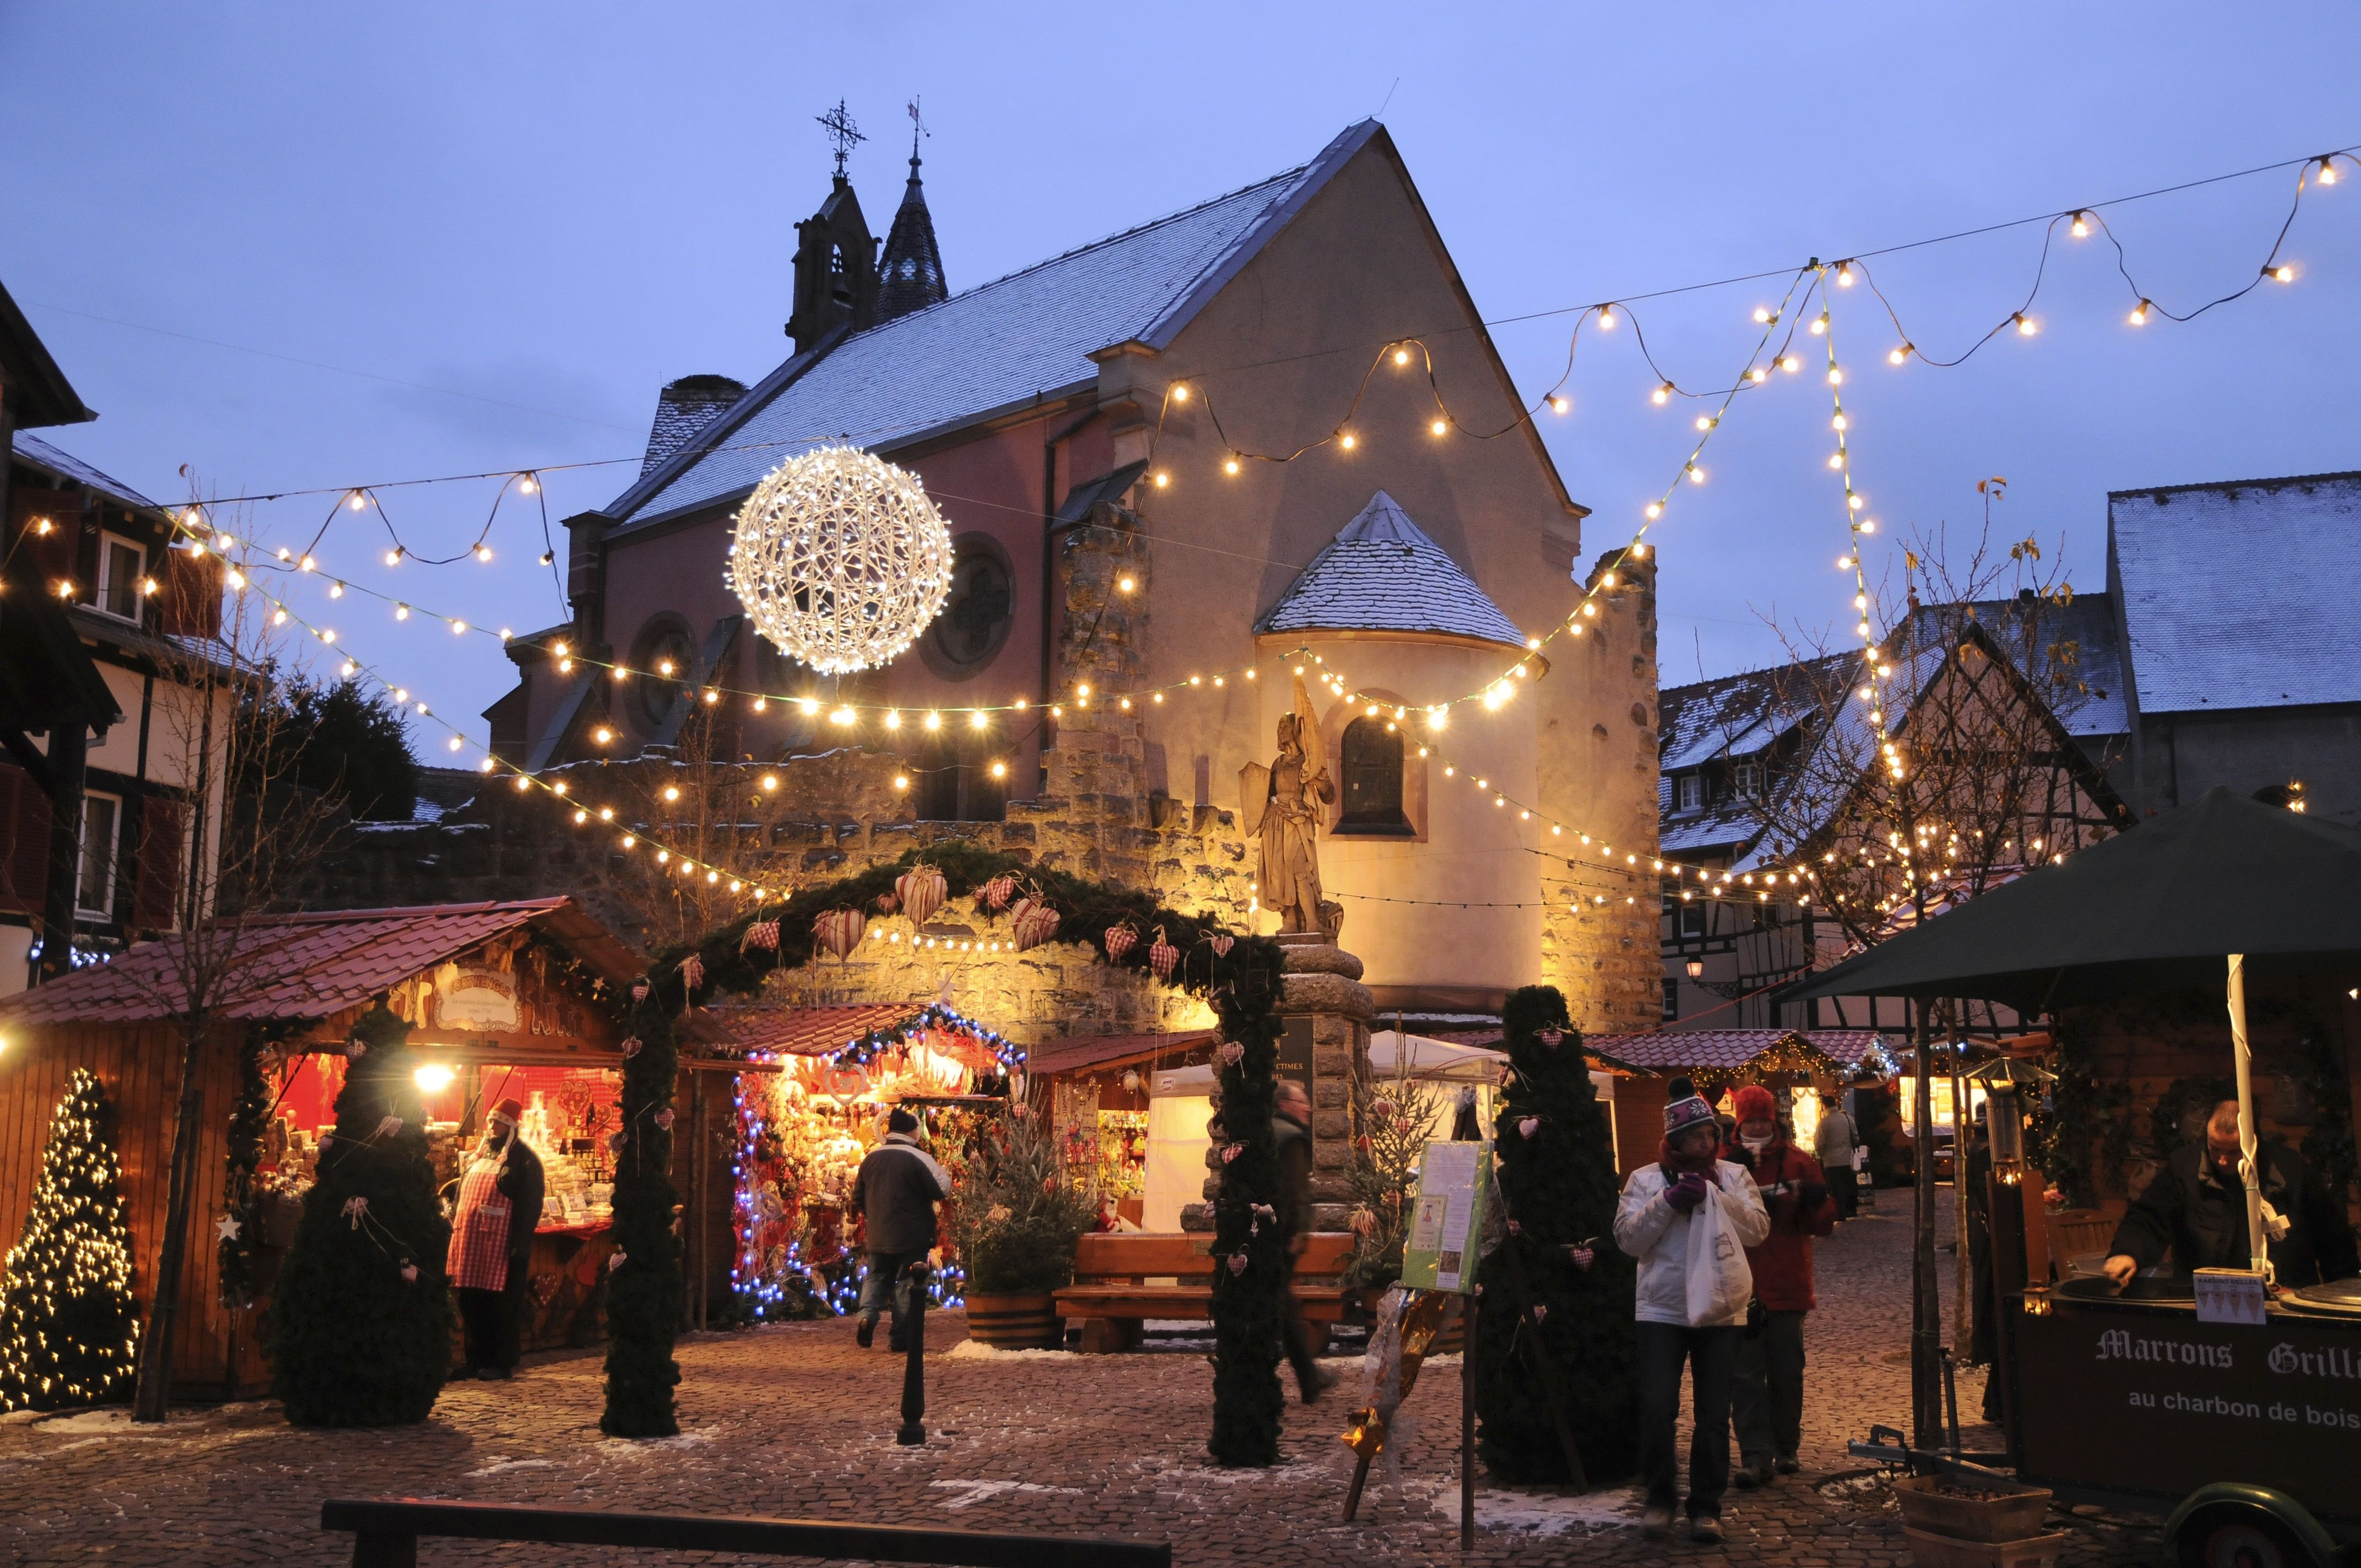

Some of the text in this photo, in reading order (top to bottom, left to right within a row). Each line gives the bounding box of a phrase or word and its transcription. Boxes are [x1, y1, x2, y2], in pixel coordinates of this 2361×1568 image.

[449, 974, 512, 1000] FORTWENGER
[2096, 1329, 2233, 1368] Marrons
[2129, 1392, 2361, 1429] au charbon de bois
